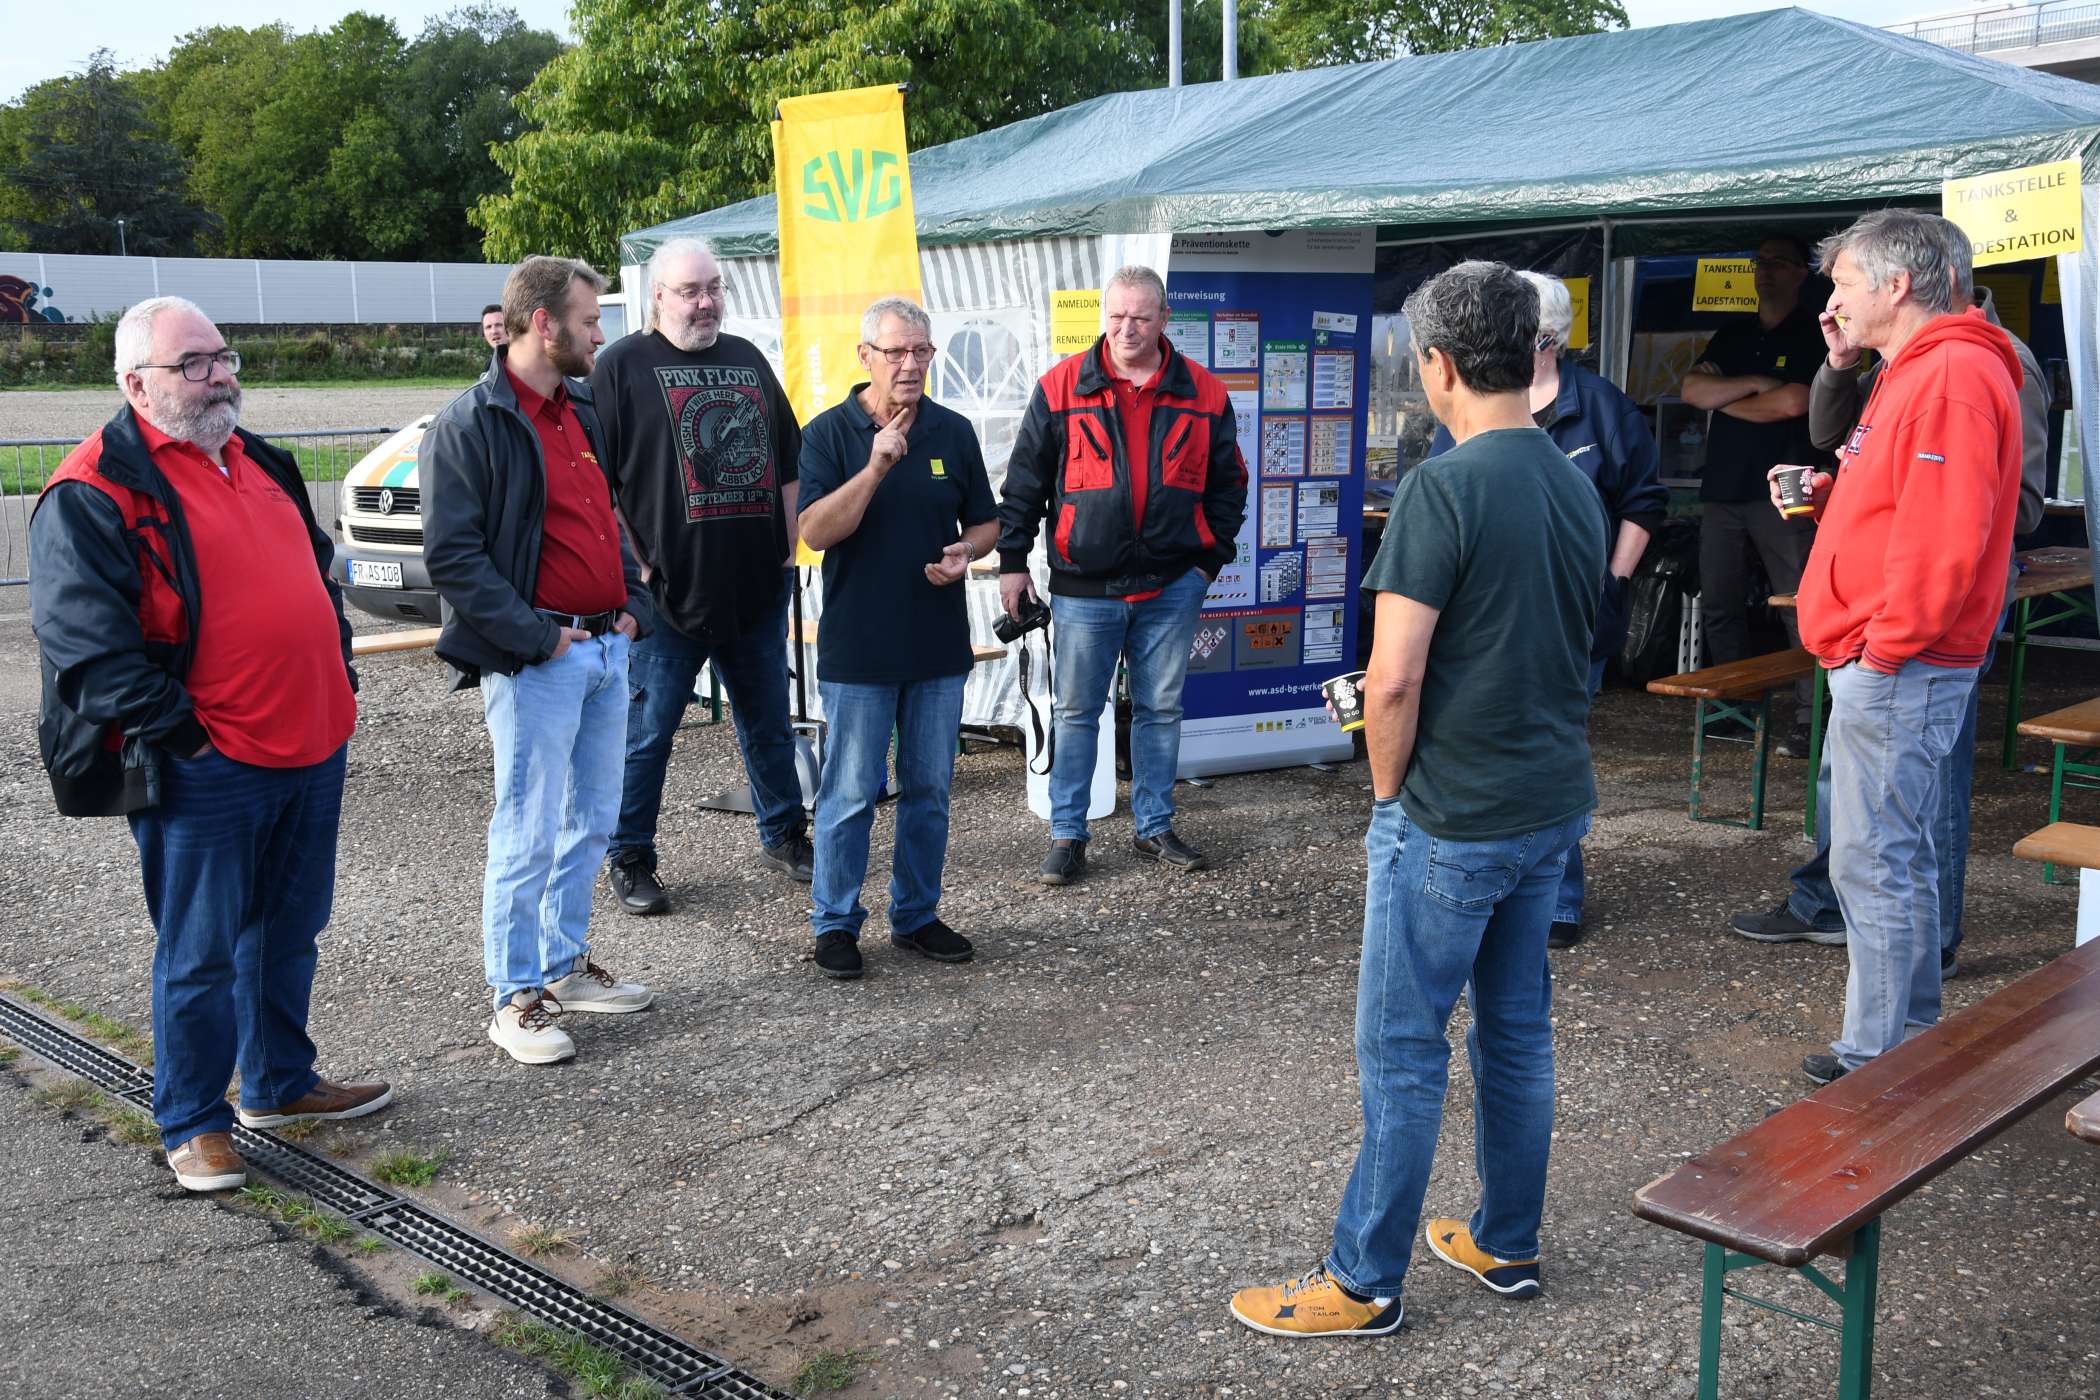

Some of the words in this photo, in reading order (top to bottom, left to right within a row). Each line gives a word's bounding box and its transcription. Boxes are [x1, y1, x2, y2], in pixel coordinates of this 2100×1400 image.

[803, 148, 901, 223] SVG
[1957, 172, 2067, 203] TANKSTELLE
[2004, 209, 2019, 223] &
[1181, 238, 1250, 249] Präventionskette
[1972, 227, 2076, 256] DESTATION
[1724, 280, 1732, 289] &
[1056, 299, 1100, 309] ANMELDUN
[1168, 291, 1226, 302] nterweisung
[1696, 296, 1757, 305] LADESTATION
[659, 368, 704, 387] PINK
[703, 368, 758, 387] FLOYD
[807, 335, 827, 411] ogistik.
[692, 391, 712, 408] WERE
[713, 390, 736, 400] HERE
[682, 405, 696, 425] YOU
[682, 425, 695, 452] WISH
[721, 473, 750, 484] ABBEY
[688, 490, 745, 506] SEPTEMBER
[353, 563, 364, 581] FR
[369, 564, 380, 581] AS
[382, 565, 400, 582] 108
[1248, 682, 1323, 697] www.asd-bg-verke
